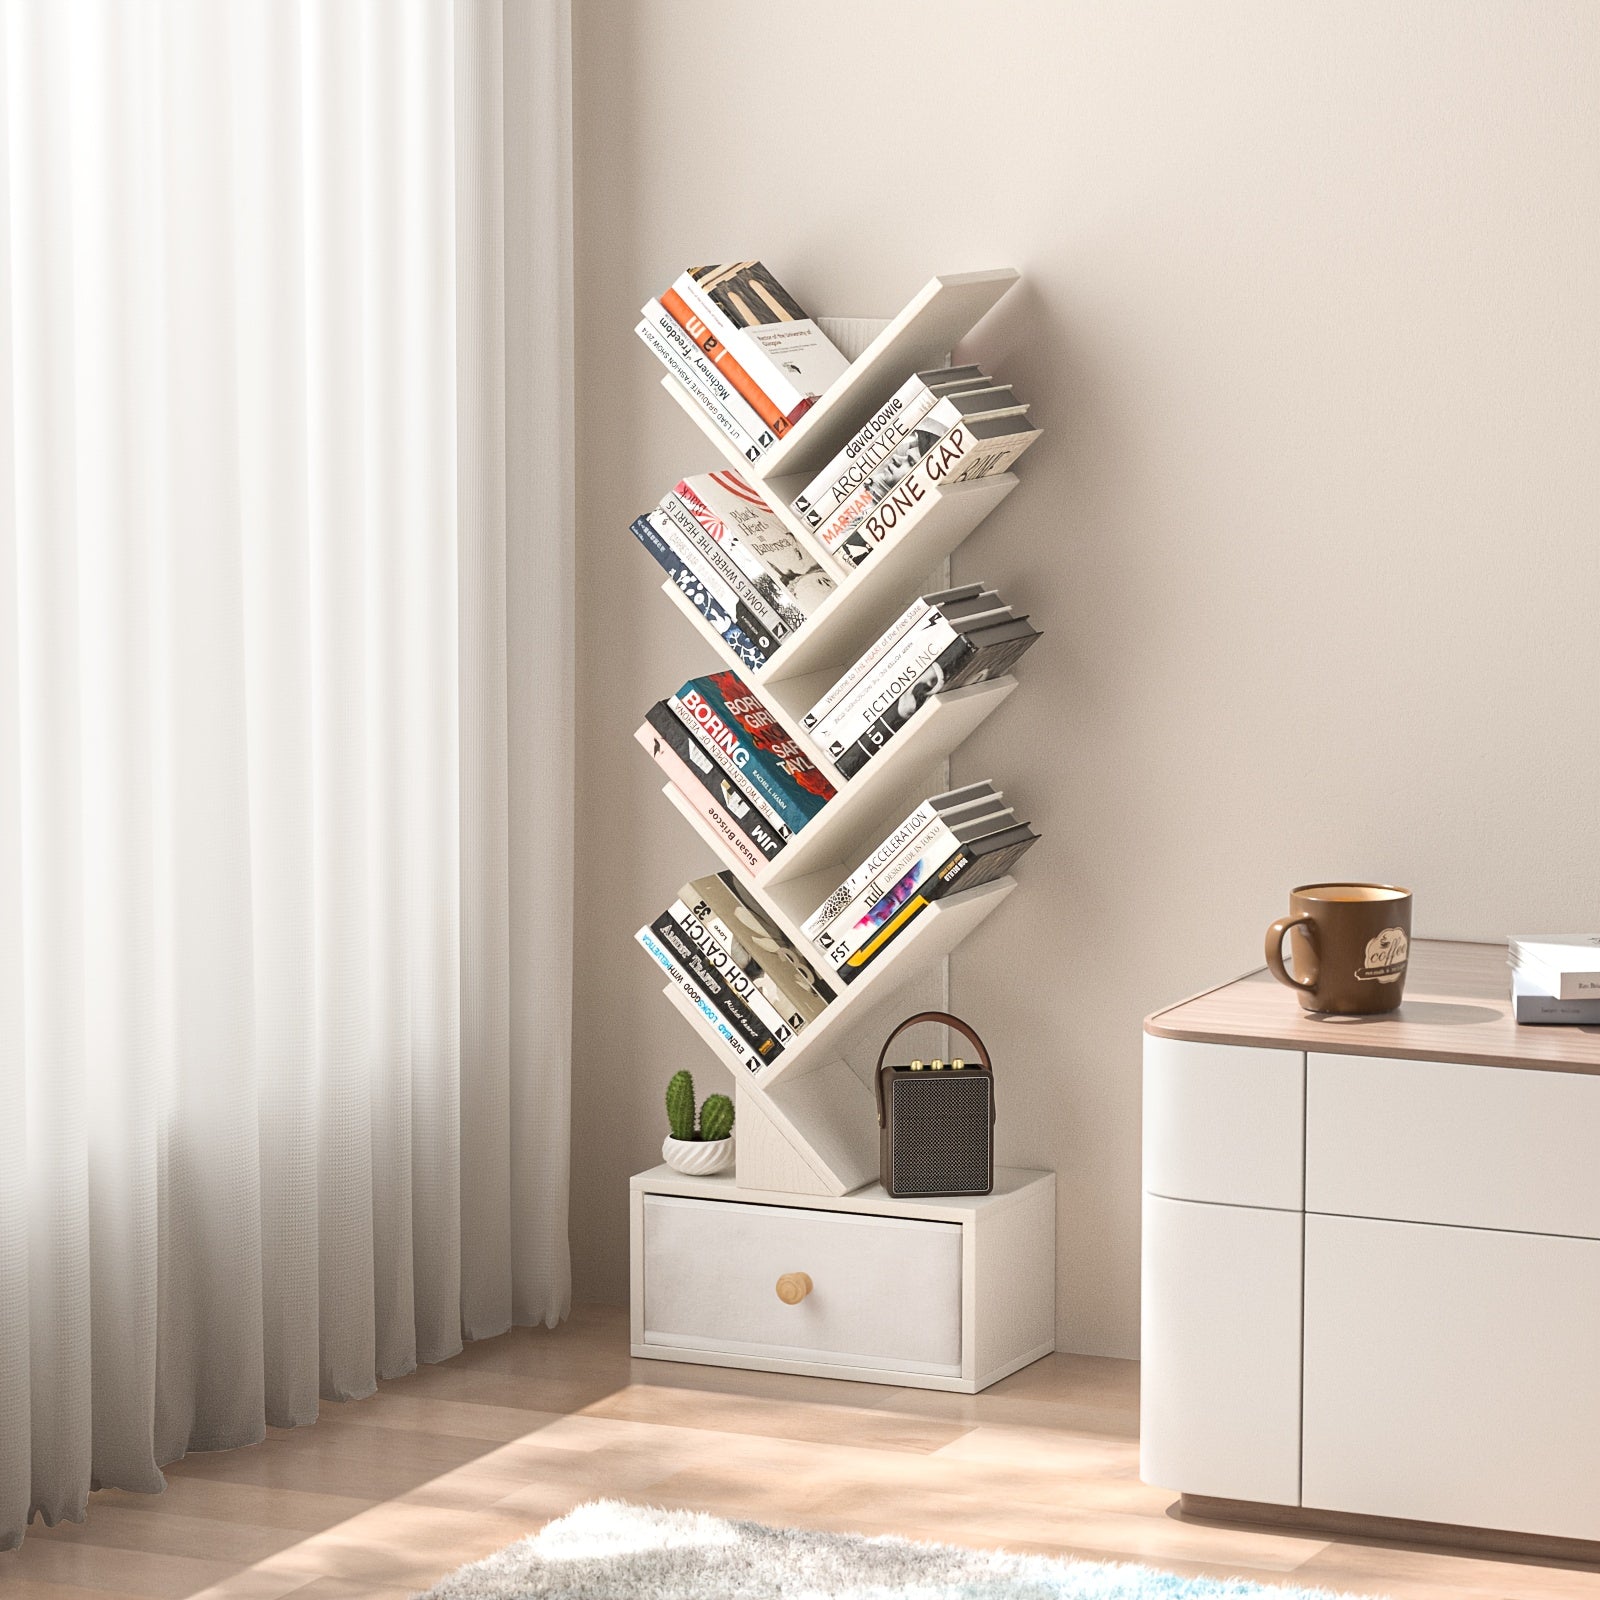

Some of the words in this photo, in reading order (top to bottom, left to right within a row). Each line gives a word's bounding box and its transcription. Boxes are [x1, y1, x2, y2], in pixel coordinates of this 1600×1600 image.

[641, 327, 654, 342] 2014
[659, 317, 692, 357] Freedom
[685, 315, 706, 339] m
[653, 340, 669, 359] SHOW
[703, 336, 718, 352] a
[694, 358, 730, 401] Machinery
[692, 384, 718, 414] GRADUATE
[846, 427, 873, 459] david
[872, 398, 903, 432] bowie
[831, 418, 909, 503] ARCHITYPE
[866, 476, 926, 542] BONE
[925, 429, 964, 483] GAP
[666, 500, 679, 513] IS
[729, 506, 759, 523] Black
[822, 488, 874, 544] MARTIAN
[673, 509, 700, 540] HEART
[738, 521, 769, 536] Hearts
[697, 536, 712, 553] THE
[752, 539, 791, 555] Battersea
[711, 553, 738, 582] WHERE
[735, 579, 745, 591] IS
[744, 590, 768, 617] HOME
[864, 645, 884, 664] HEART
[886, 628, 898, 642] the
[895, 617, 909, 633] Free
[907, 605, 922, 620] State
[862, 666, 917, 723] FICTIONS
[916, 642, 944, 670] INC.
[673, 702, 701, 733] VERONA
[682, 689, 750, 769] BORING
[698, 731, 711, 745] OF
[866, 725, 885, 749] I.D.
[708, 743, 748, 788] GENTLEMEN
[743, 784, 761, 802] TWO
[751, 769, 770, 790] RACHEL
[708, 807, 735, 839] Briscoe
[758, 801, 774, 818] THE
[751, 824, 777, 851] JIM
[868, 811, 927, 874] ACCELERATION
[918, 823, 940, 846] TOKYO
[735, 840, 758, 866] Susan
[693, 900, 712, 921] 32
[681, 914, 728, 968] CATCH
[831, 941, 850, 963] FST
[1371, 937, 1406, 966] coffee
[725, 969, 756, 1003] TCH
